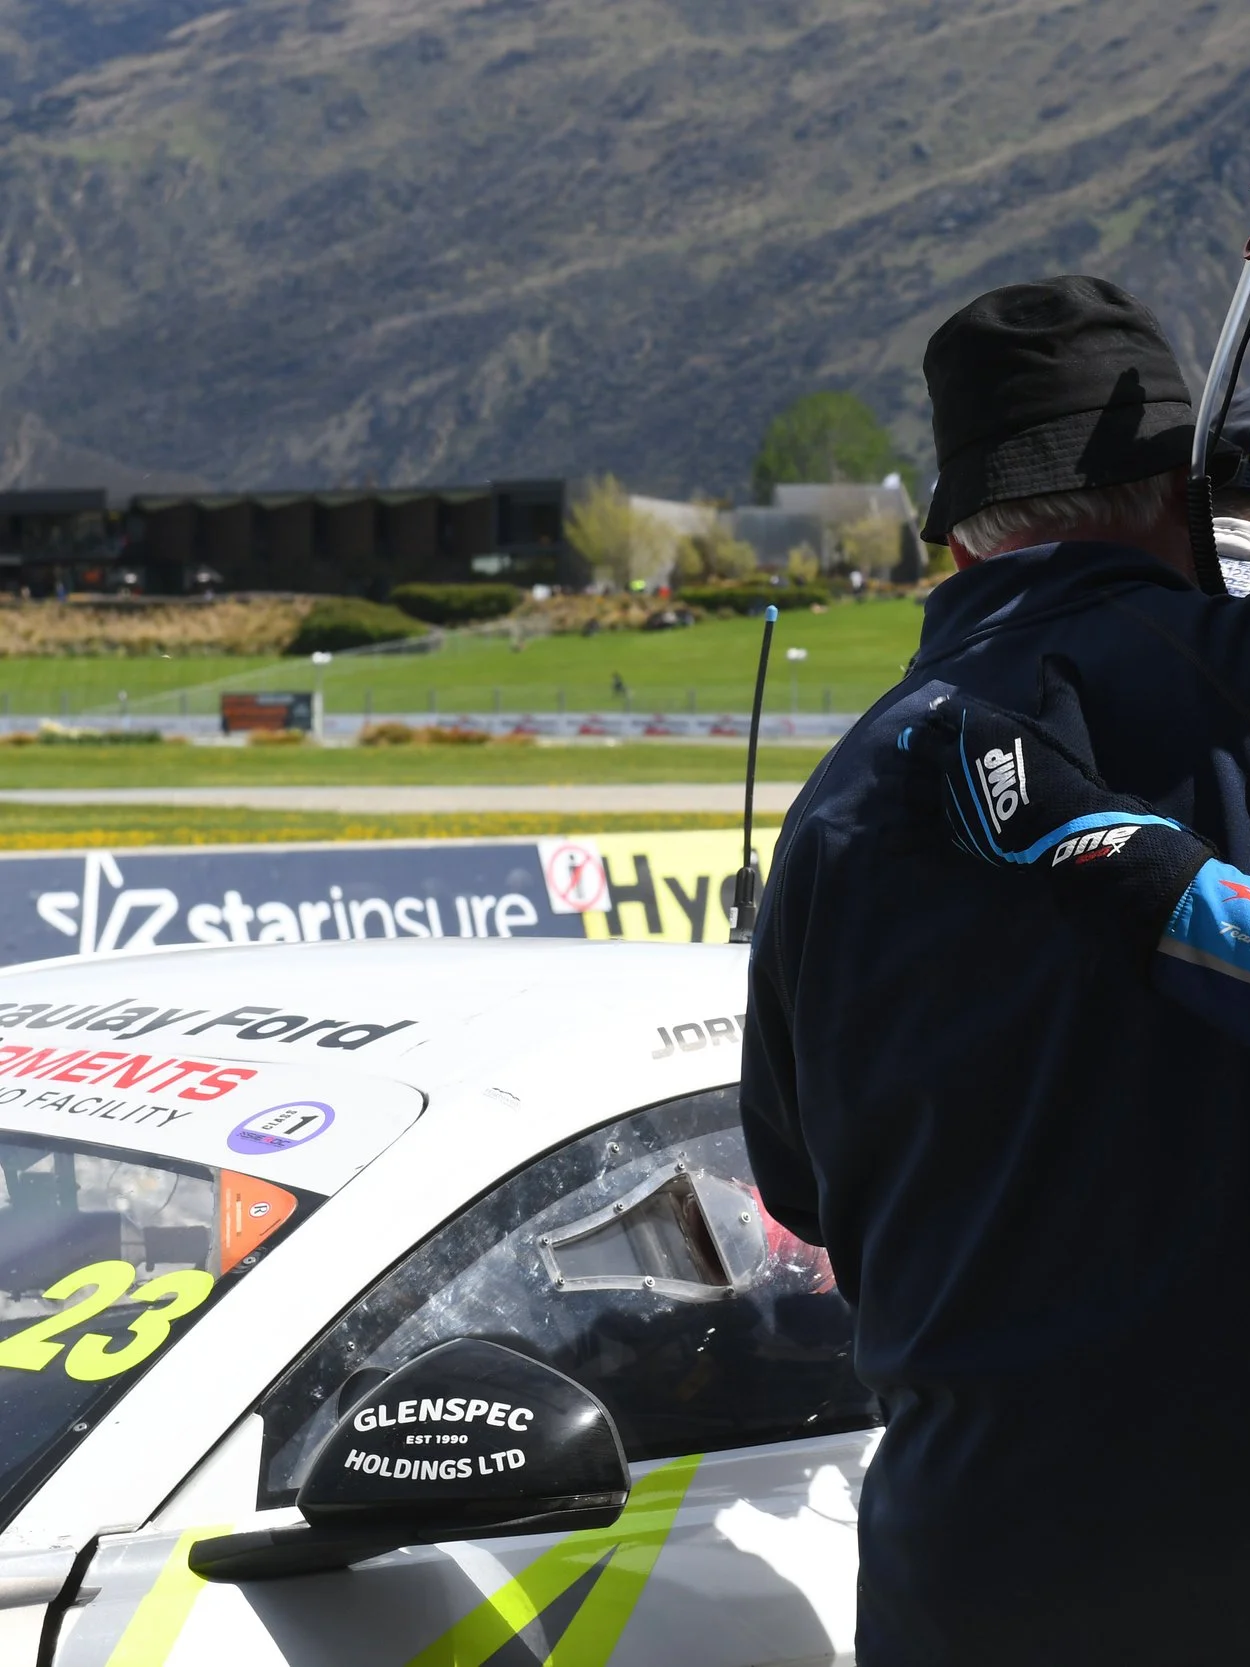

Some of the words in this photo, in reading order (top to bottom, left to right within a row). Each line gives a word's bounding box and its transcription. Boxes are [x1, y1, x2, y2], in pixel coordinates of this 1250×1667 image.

[984, 748, 1019, 821] OMP
[187, 886, 538, 944] starinsure
[181, 1005, 418, 1051] Ford
[24, 1091, 193, 1128] FACILITY
[262, 1109, 298, 1130] CLASS
[284, 1115, 319, 1135] 1
[0, 1260, 214, 1381] 23
[354, 1398, 534, 1432] GLENSPEC
[406, 1435, 432, 1444] EST
[436, 1435, 468, 1444] 1990
[344, 1449, 473, 1480] HOLDINGS
[478, 1449, 526, 1475] LTD
